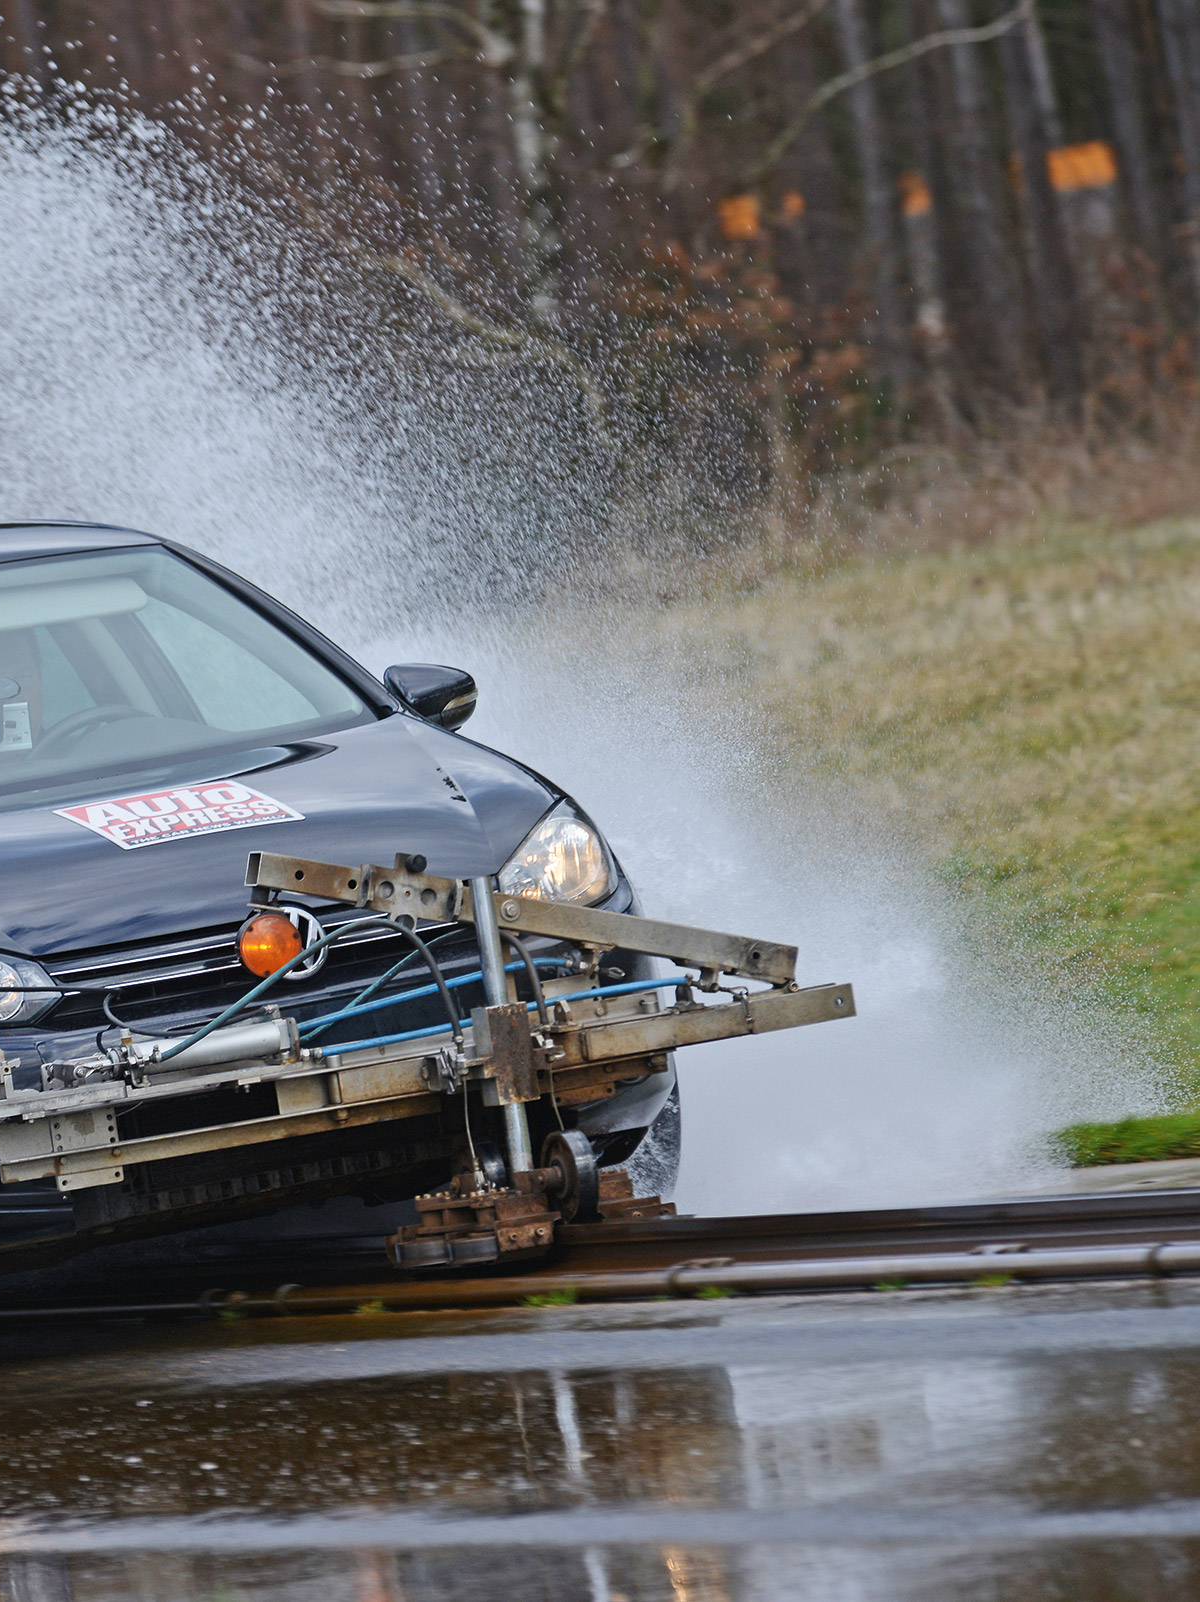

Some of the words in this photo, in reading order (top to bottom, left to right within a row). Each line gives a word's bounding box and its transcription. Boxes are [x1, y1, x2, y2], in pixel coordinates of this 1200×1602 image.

[108, 800, 281, 840] EXPRESS
[129, 834, 159, 845] THE
[161, 829, 189, 839] CAR
[192, 822, 231, 833] NEWS
[233, 813, 286, 827] WEEKLY
